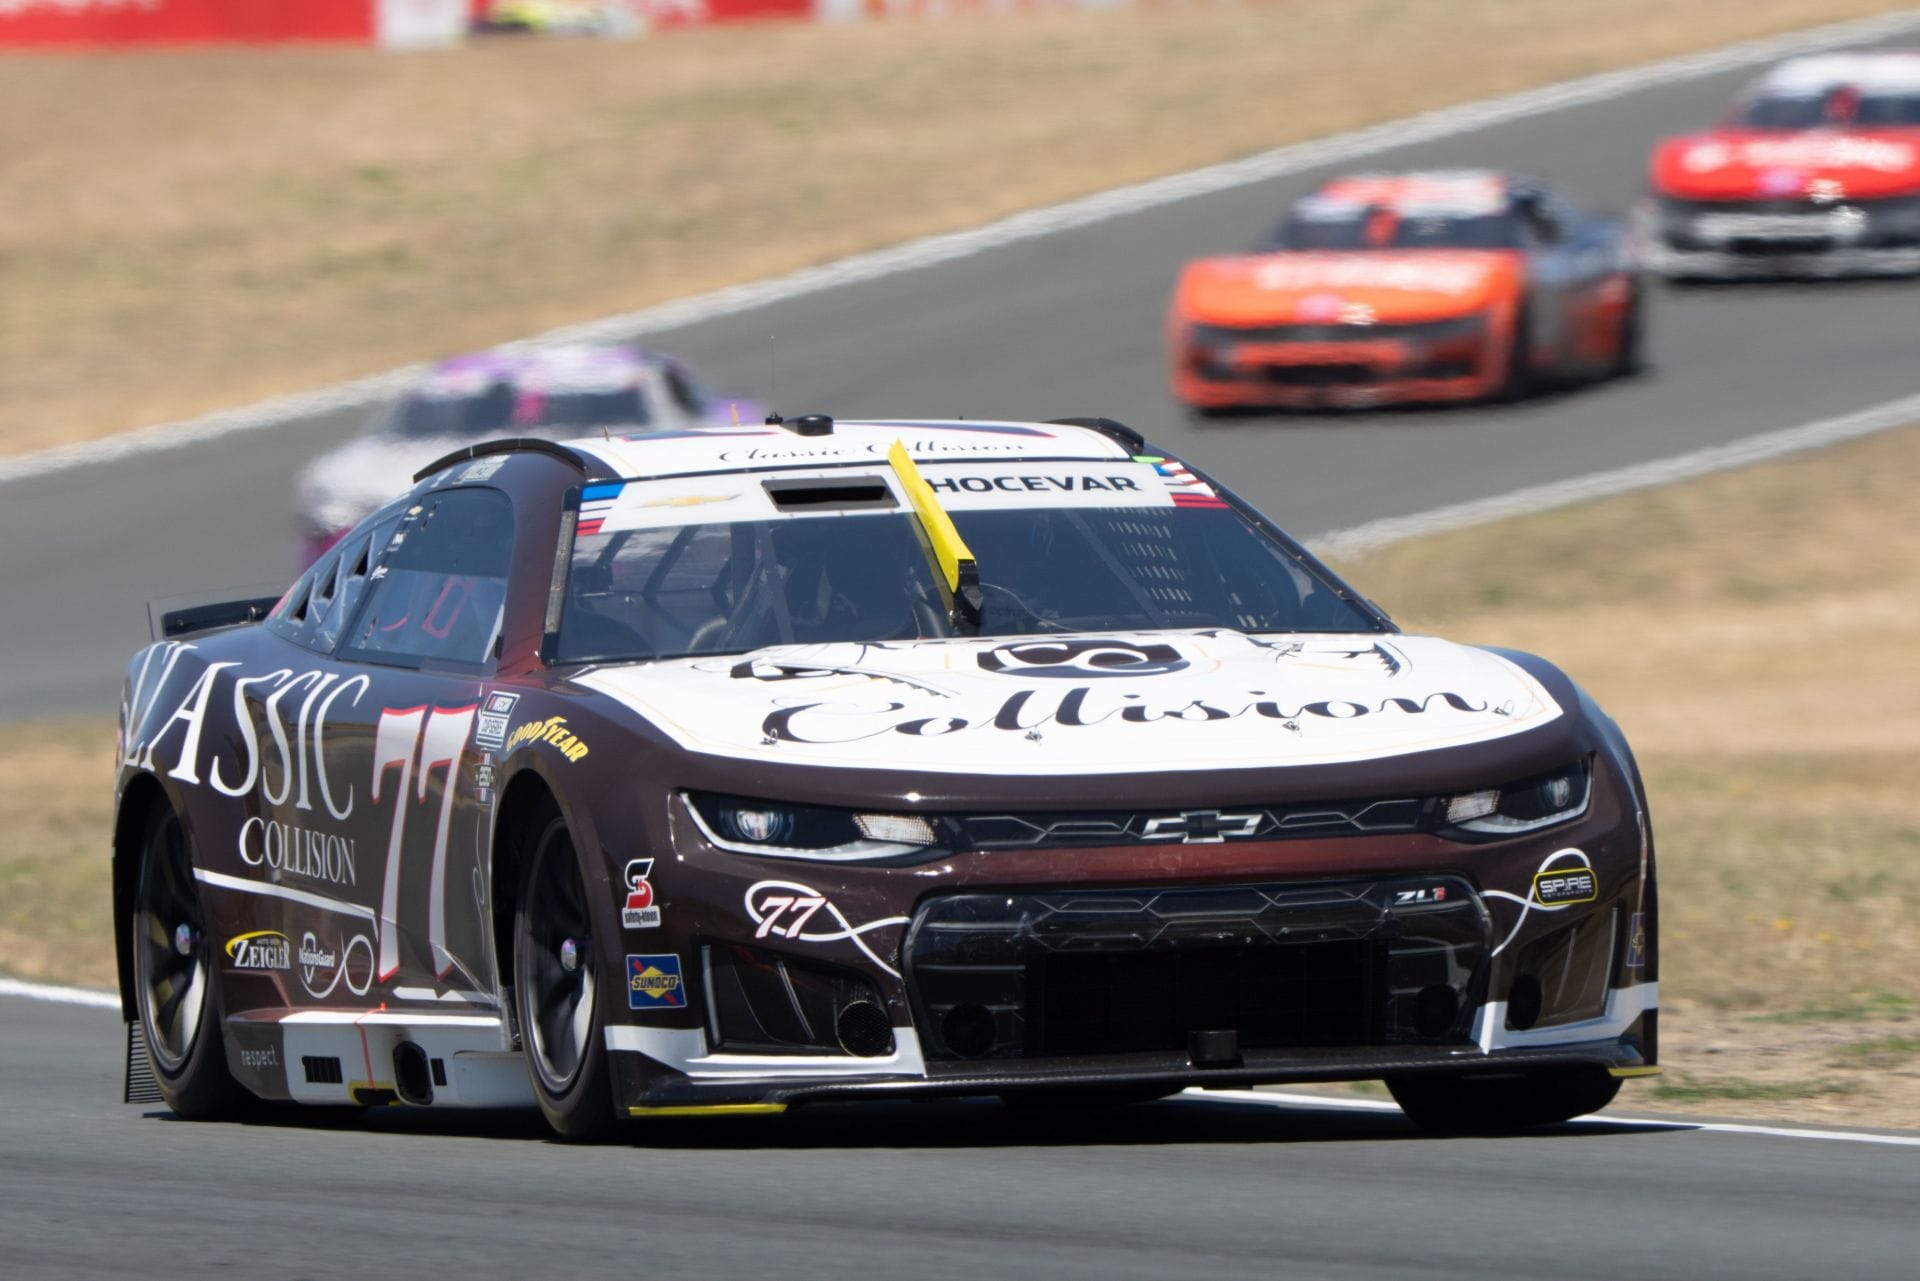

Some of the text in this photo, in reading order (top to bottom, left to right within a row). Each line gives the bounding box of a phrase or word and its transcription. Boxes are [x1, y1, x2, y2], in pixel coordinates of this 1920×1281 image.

[719, 440, 1024, 462] Classic Cllision
[926, 476, 1141, 493] HOCEVAR
[762, 687, 1489, 743] Collision
[506, 716, 588, 762] GOODYEAR
[239, 817, 356, 886] COLLISION
[372, 704, 478, 982] 77
[755, 897, 826, 938] 77
[234, 939, 290, 969] ZEIGLER
[633, 976, 678, 989] SUNOCO
[241, 1044, 279, 1071] respect
